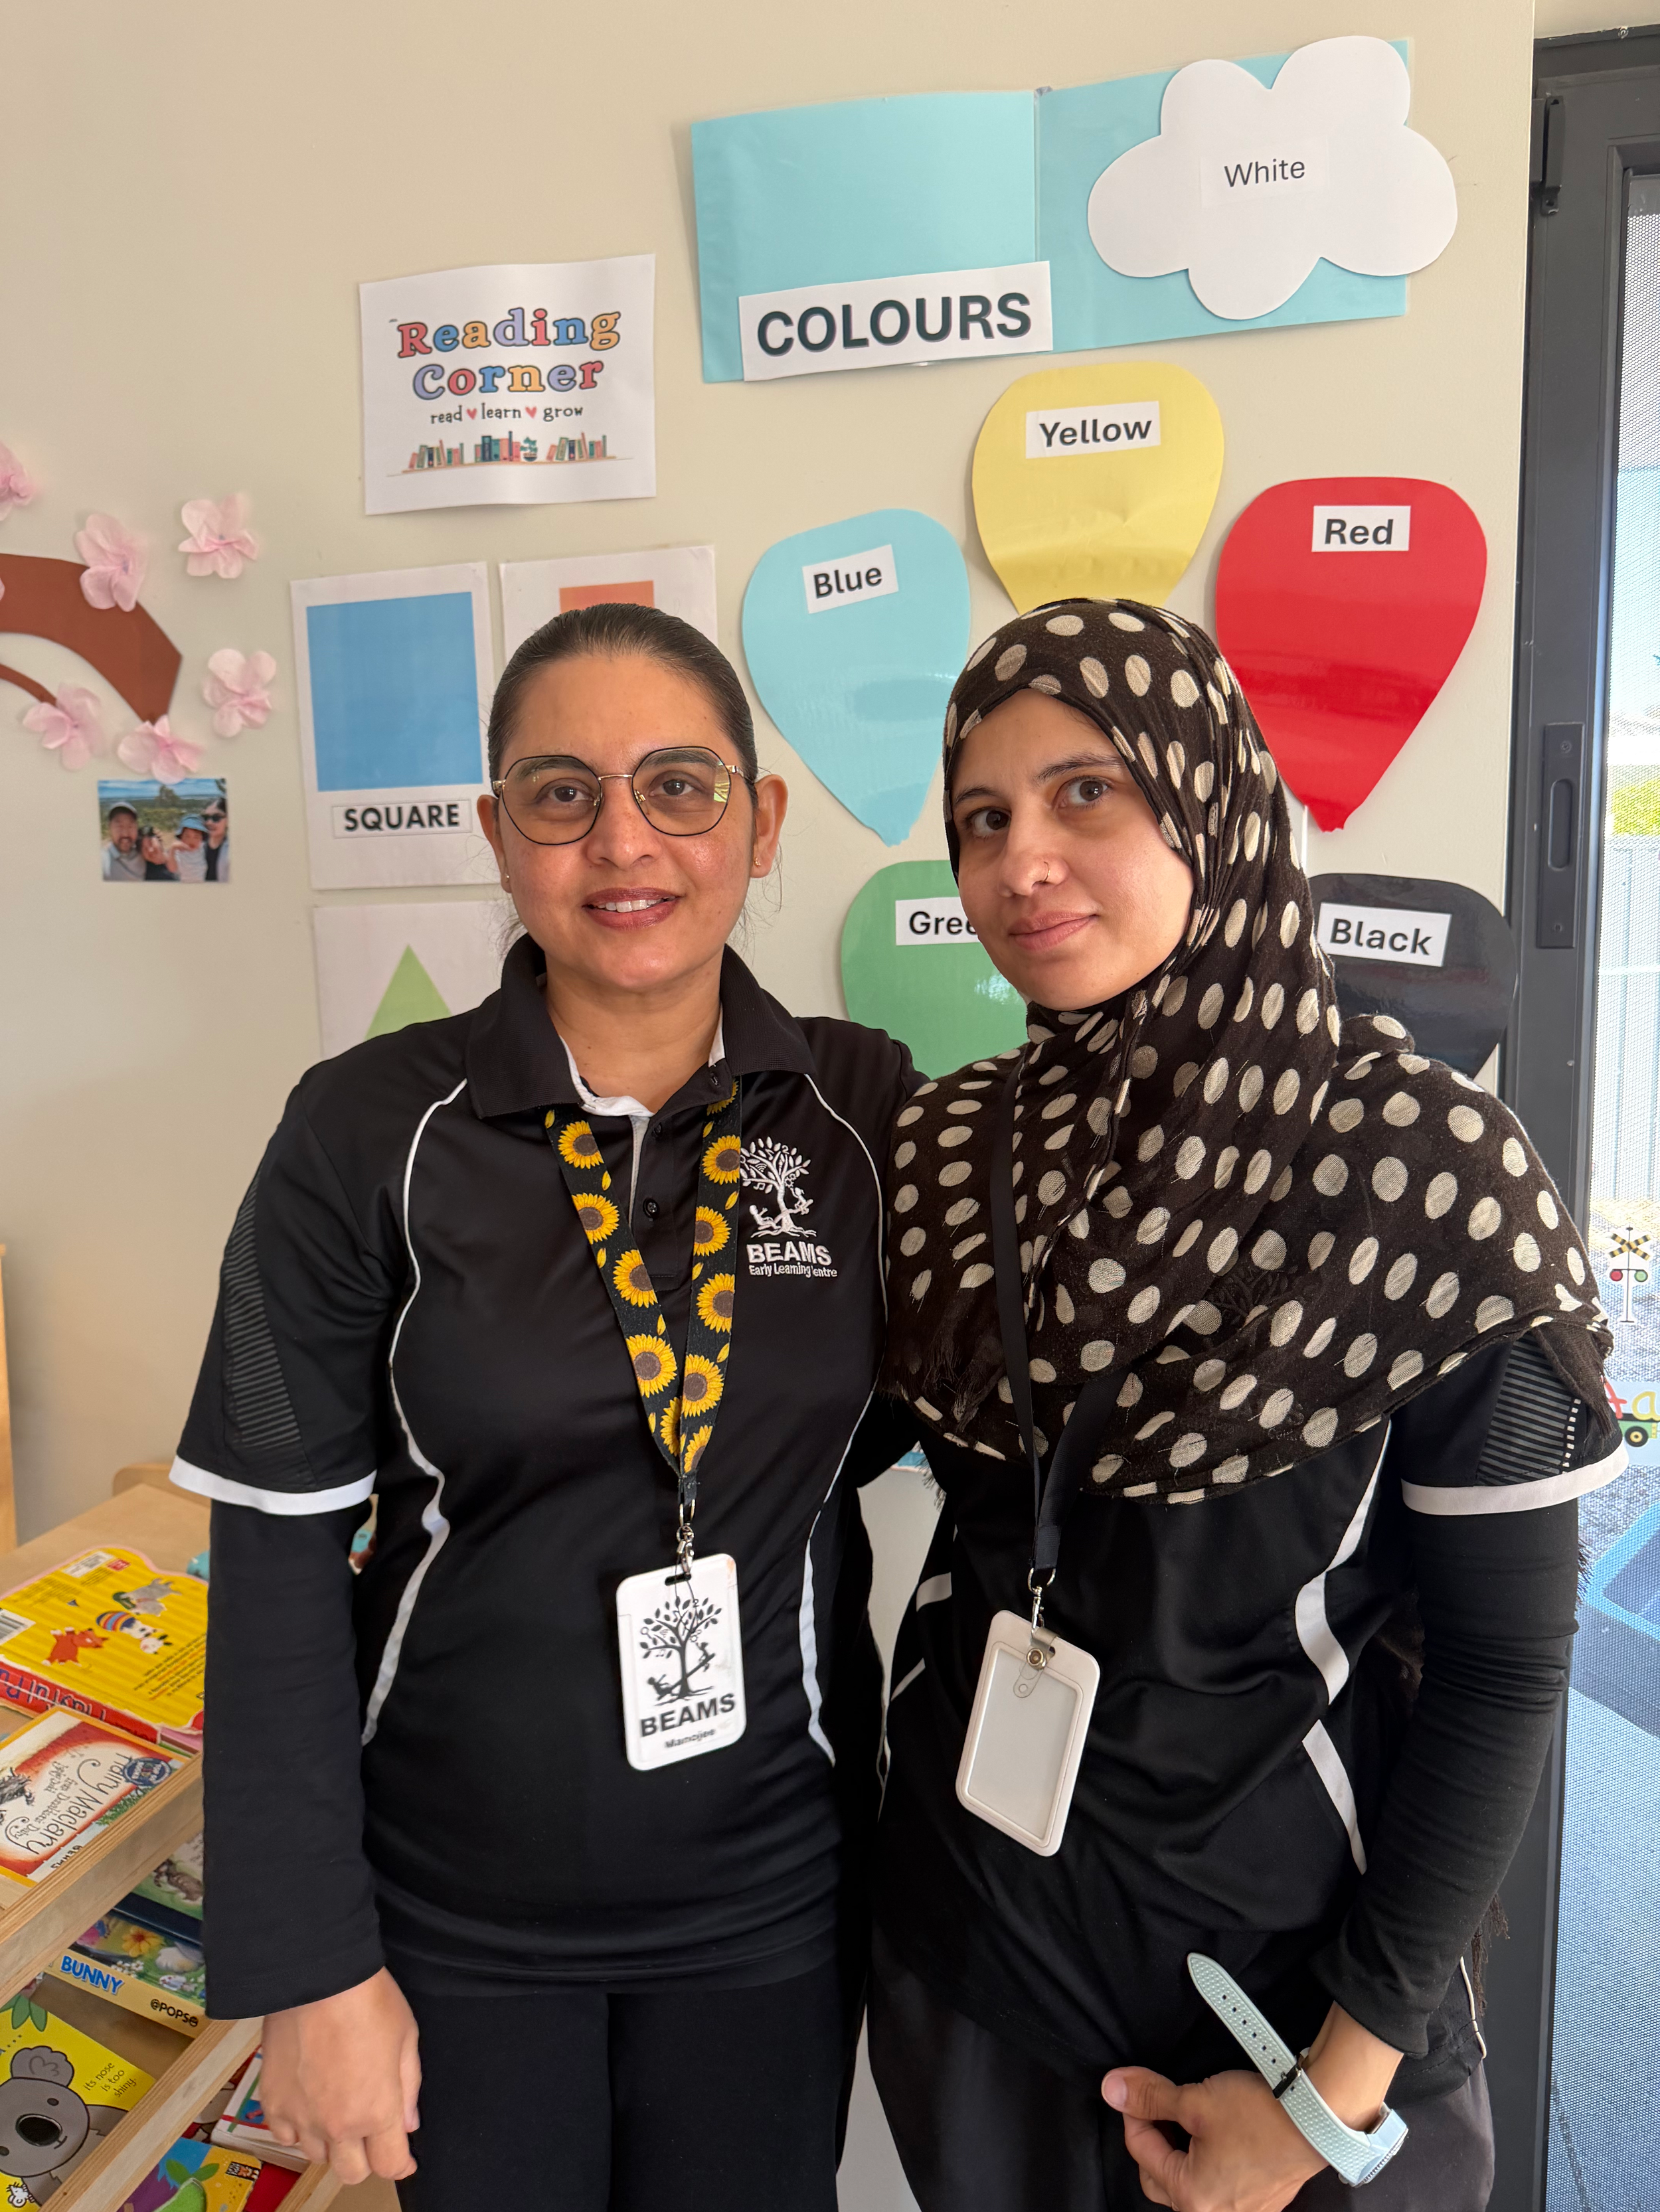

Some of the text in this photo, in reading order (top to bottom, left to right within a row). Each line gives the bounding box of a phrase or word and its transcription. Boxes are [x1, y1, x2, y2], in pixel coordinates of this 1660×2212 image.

[1224, 158, 1305, 187] White
[397, 307, 621, 358] Reading
[758, 292, 1032, 357] COLOURS
[412, 360, 604, 400] Corner
[430, 402, 584, 424] read learn grow
[1039, 419, 1152, 447] Yellow
[1325, 518, 1394, 545] Red
[813, 568, 882, 599] Blue
[345, 804, 459, 830] SQUARE
[1330, 918, 1432, 955] Black
[746, 1241, 832, 1265] BEAMS
[749, 1262, 838, 1278] Early Learning entre
[640, 1693, 735, 1737] BEAMS
[5, 1788, 104, 1855] Maclary
[60, 1954, 124, 1995] BUNNY
[95, 2063, 115, 2081] nose
[108, 2070, 125, 2084] too
